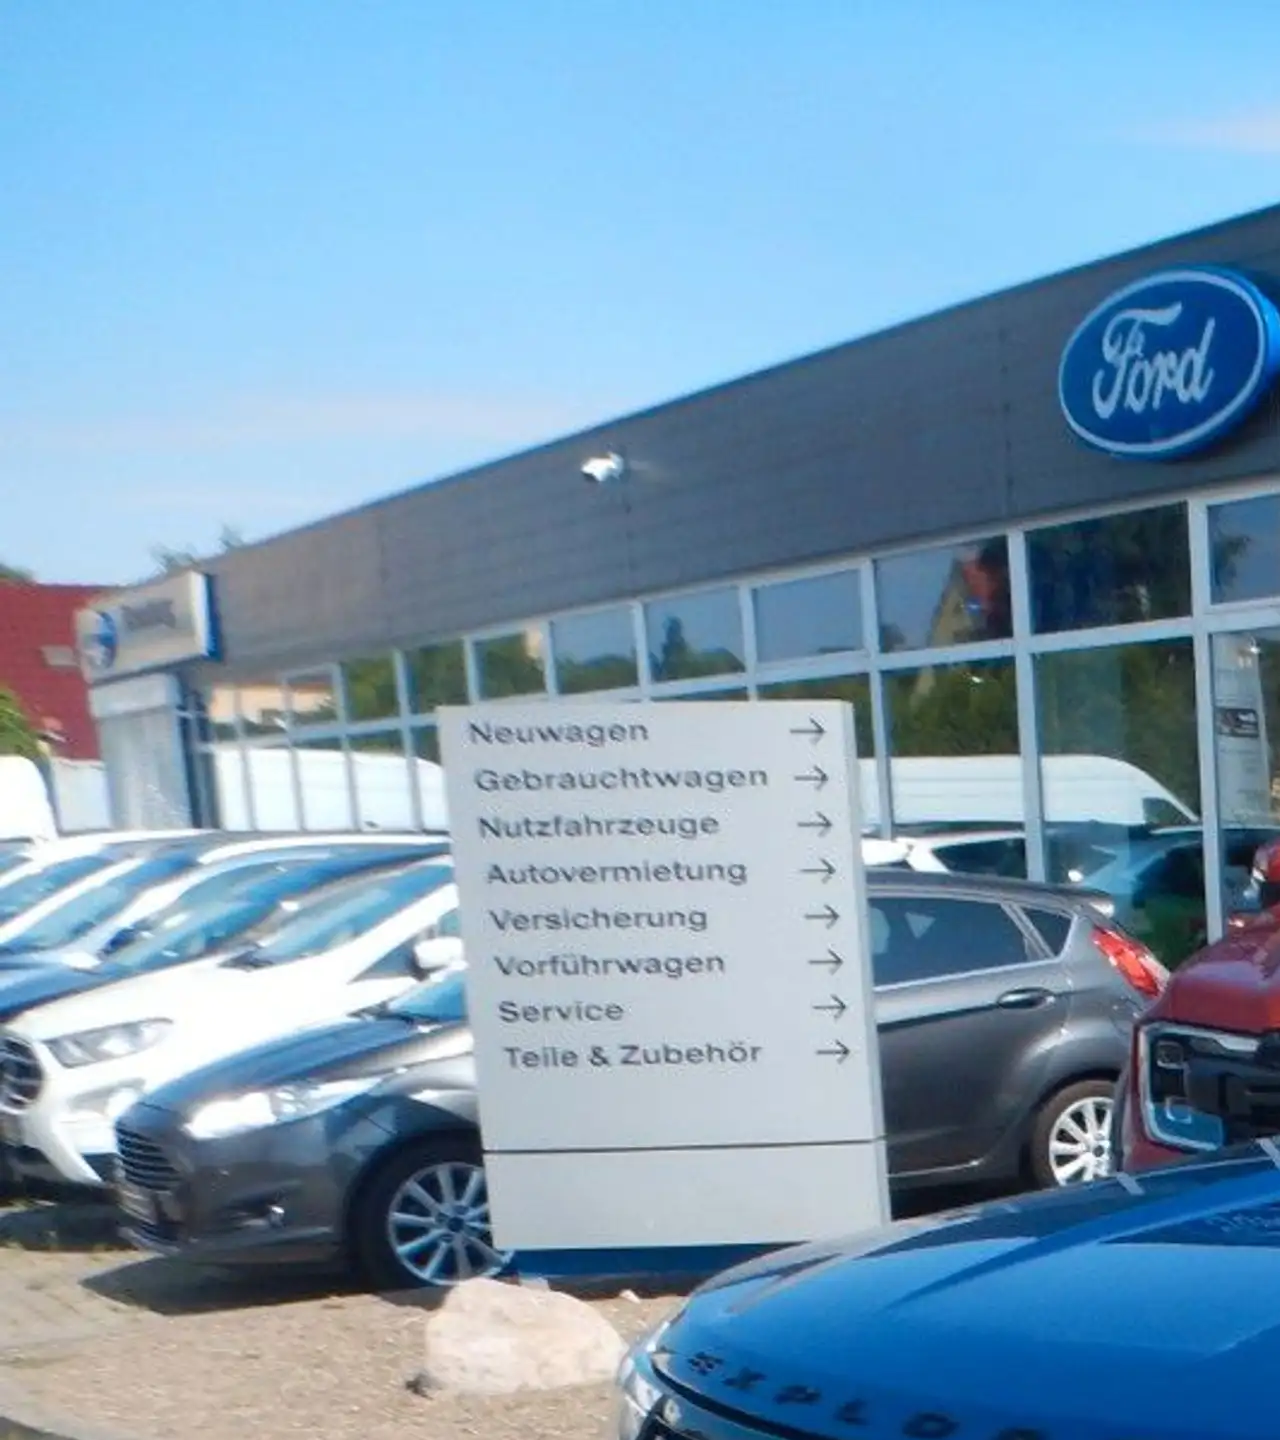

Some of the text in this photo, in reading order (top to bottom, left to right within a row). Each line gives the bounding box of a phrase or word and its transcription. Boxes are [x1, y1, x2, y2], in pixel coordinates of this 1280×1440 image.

[1092, 302, 1216, 420] Ford
[470, 720, 648, 747] Neuwagen
[475, 766, 769, 794] Gebrauchtwagen
[479, 814, 720, 840] Nutzfahrzeuge
[487, 861, 748, 886] Autovermietung
[490, 908, 709, 935] Versicherung
[493, 953, 726, 981] Vorführwagen
[499, 1000, 625, 1023] Service
[506, 1041, 763, 1069] Teile & Zubehör
